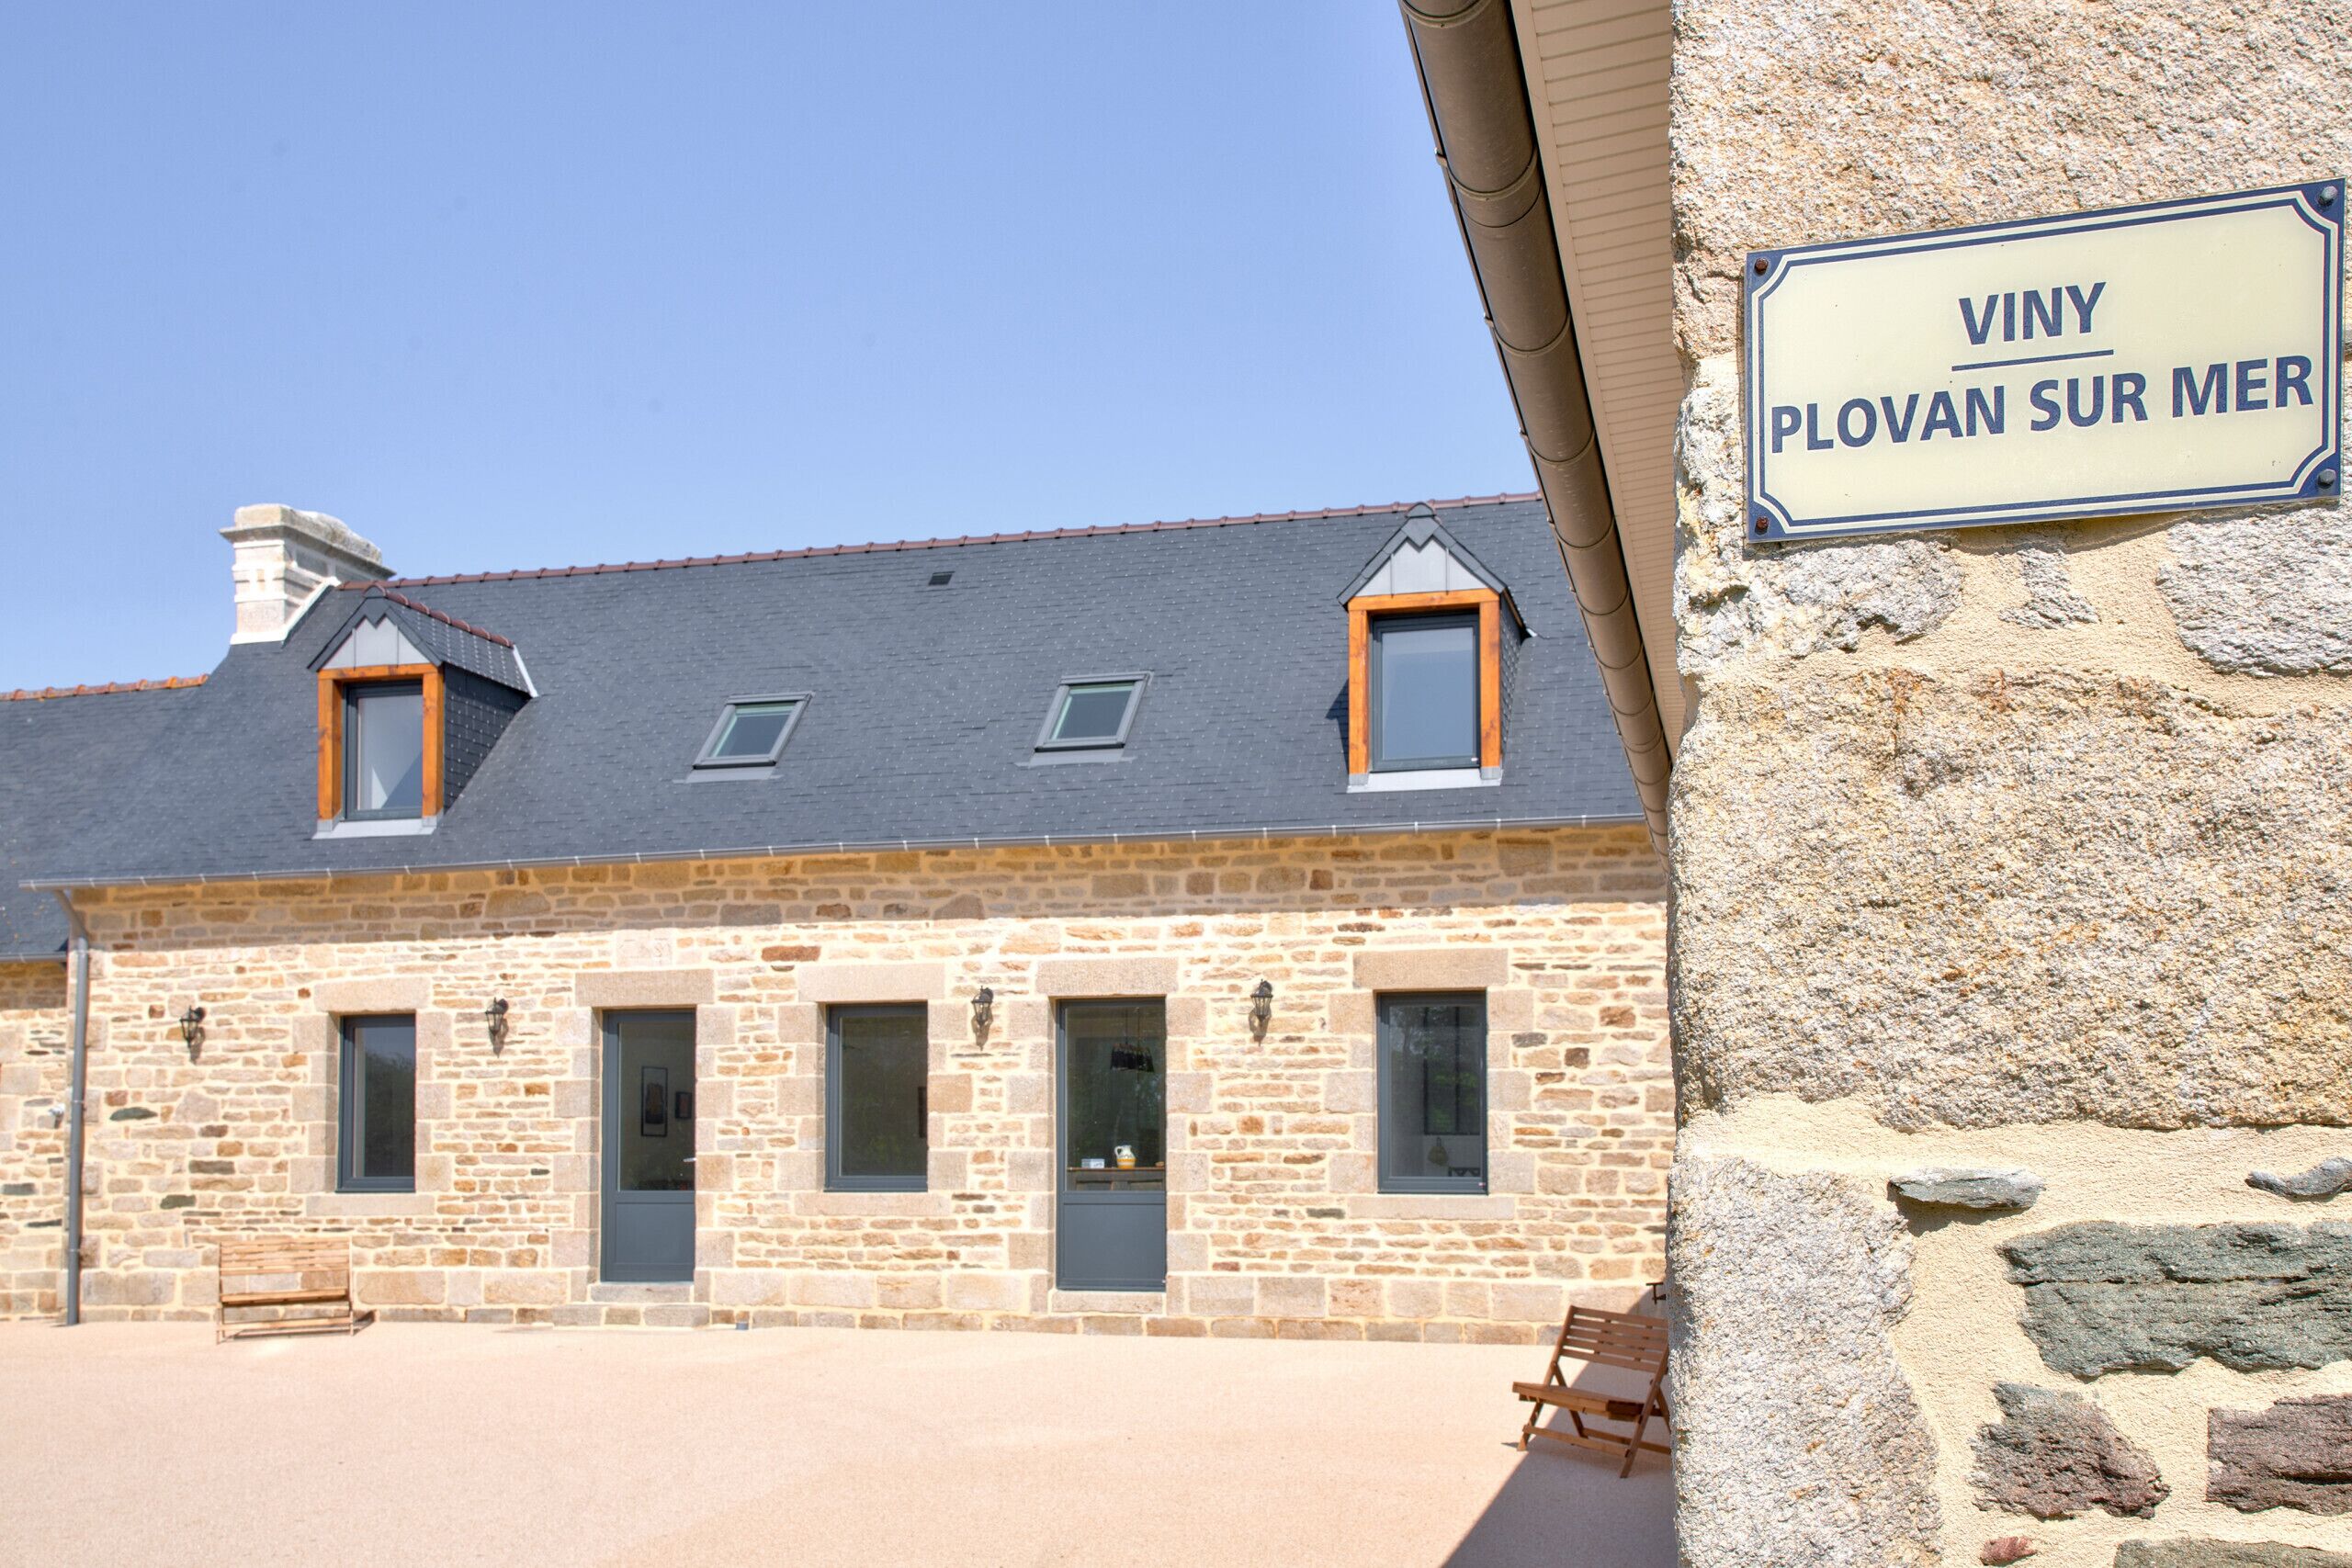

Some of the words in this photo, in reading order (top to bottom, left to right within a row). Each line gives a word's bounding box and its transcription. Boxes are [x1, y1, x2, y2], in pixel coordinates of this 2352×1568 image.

[1958, 281, 2107, 345] VINY
[1771, 385, 2005, 454] PLOVAN
[2030, 372, 2149, 432] SUR
[2172, 355, 2314, 419] MER
